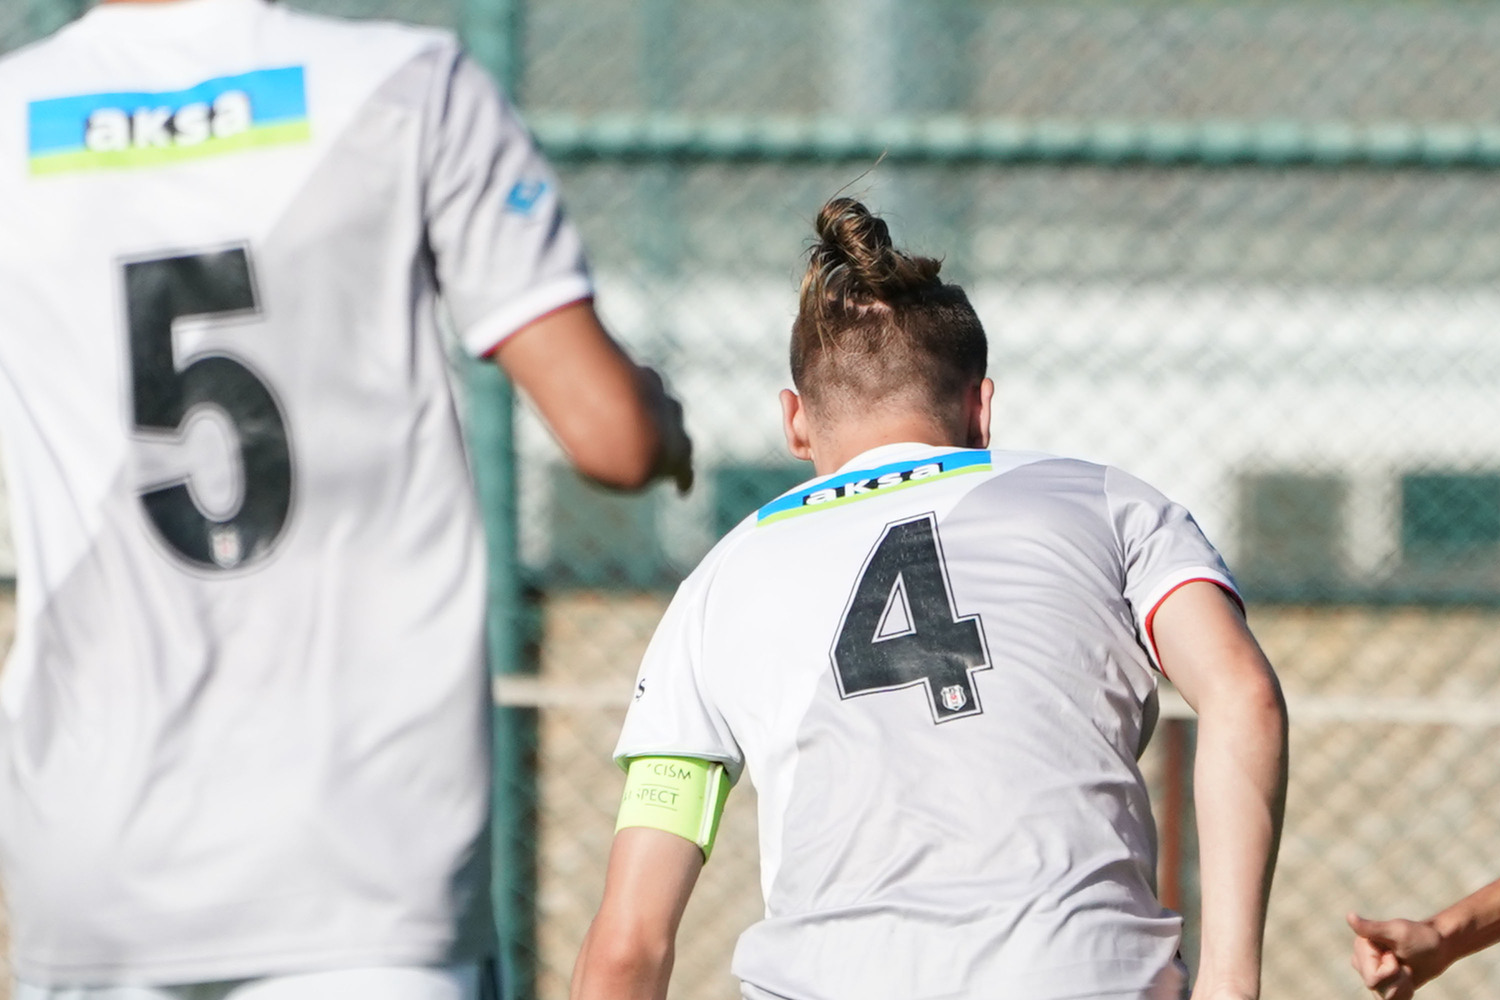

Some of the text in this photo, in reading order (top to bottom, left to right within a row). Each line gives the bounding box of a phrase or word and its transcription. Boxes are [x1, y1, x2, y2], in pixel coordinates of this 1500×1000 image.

[84, 90, 252, 152] aksa
[117, 242, 298, 577] 5
[803, 462, 943, 506] aksa
[829, 511, 993, 725] 4
